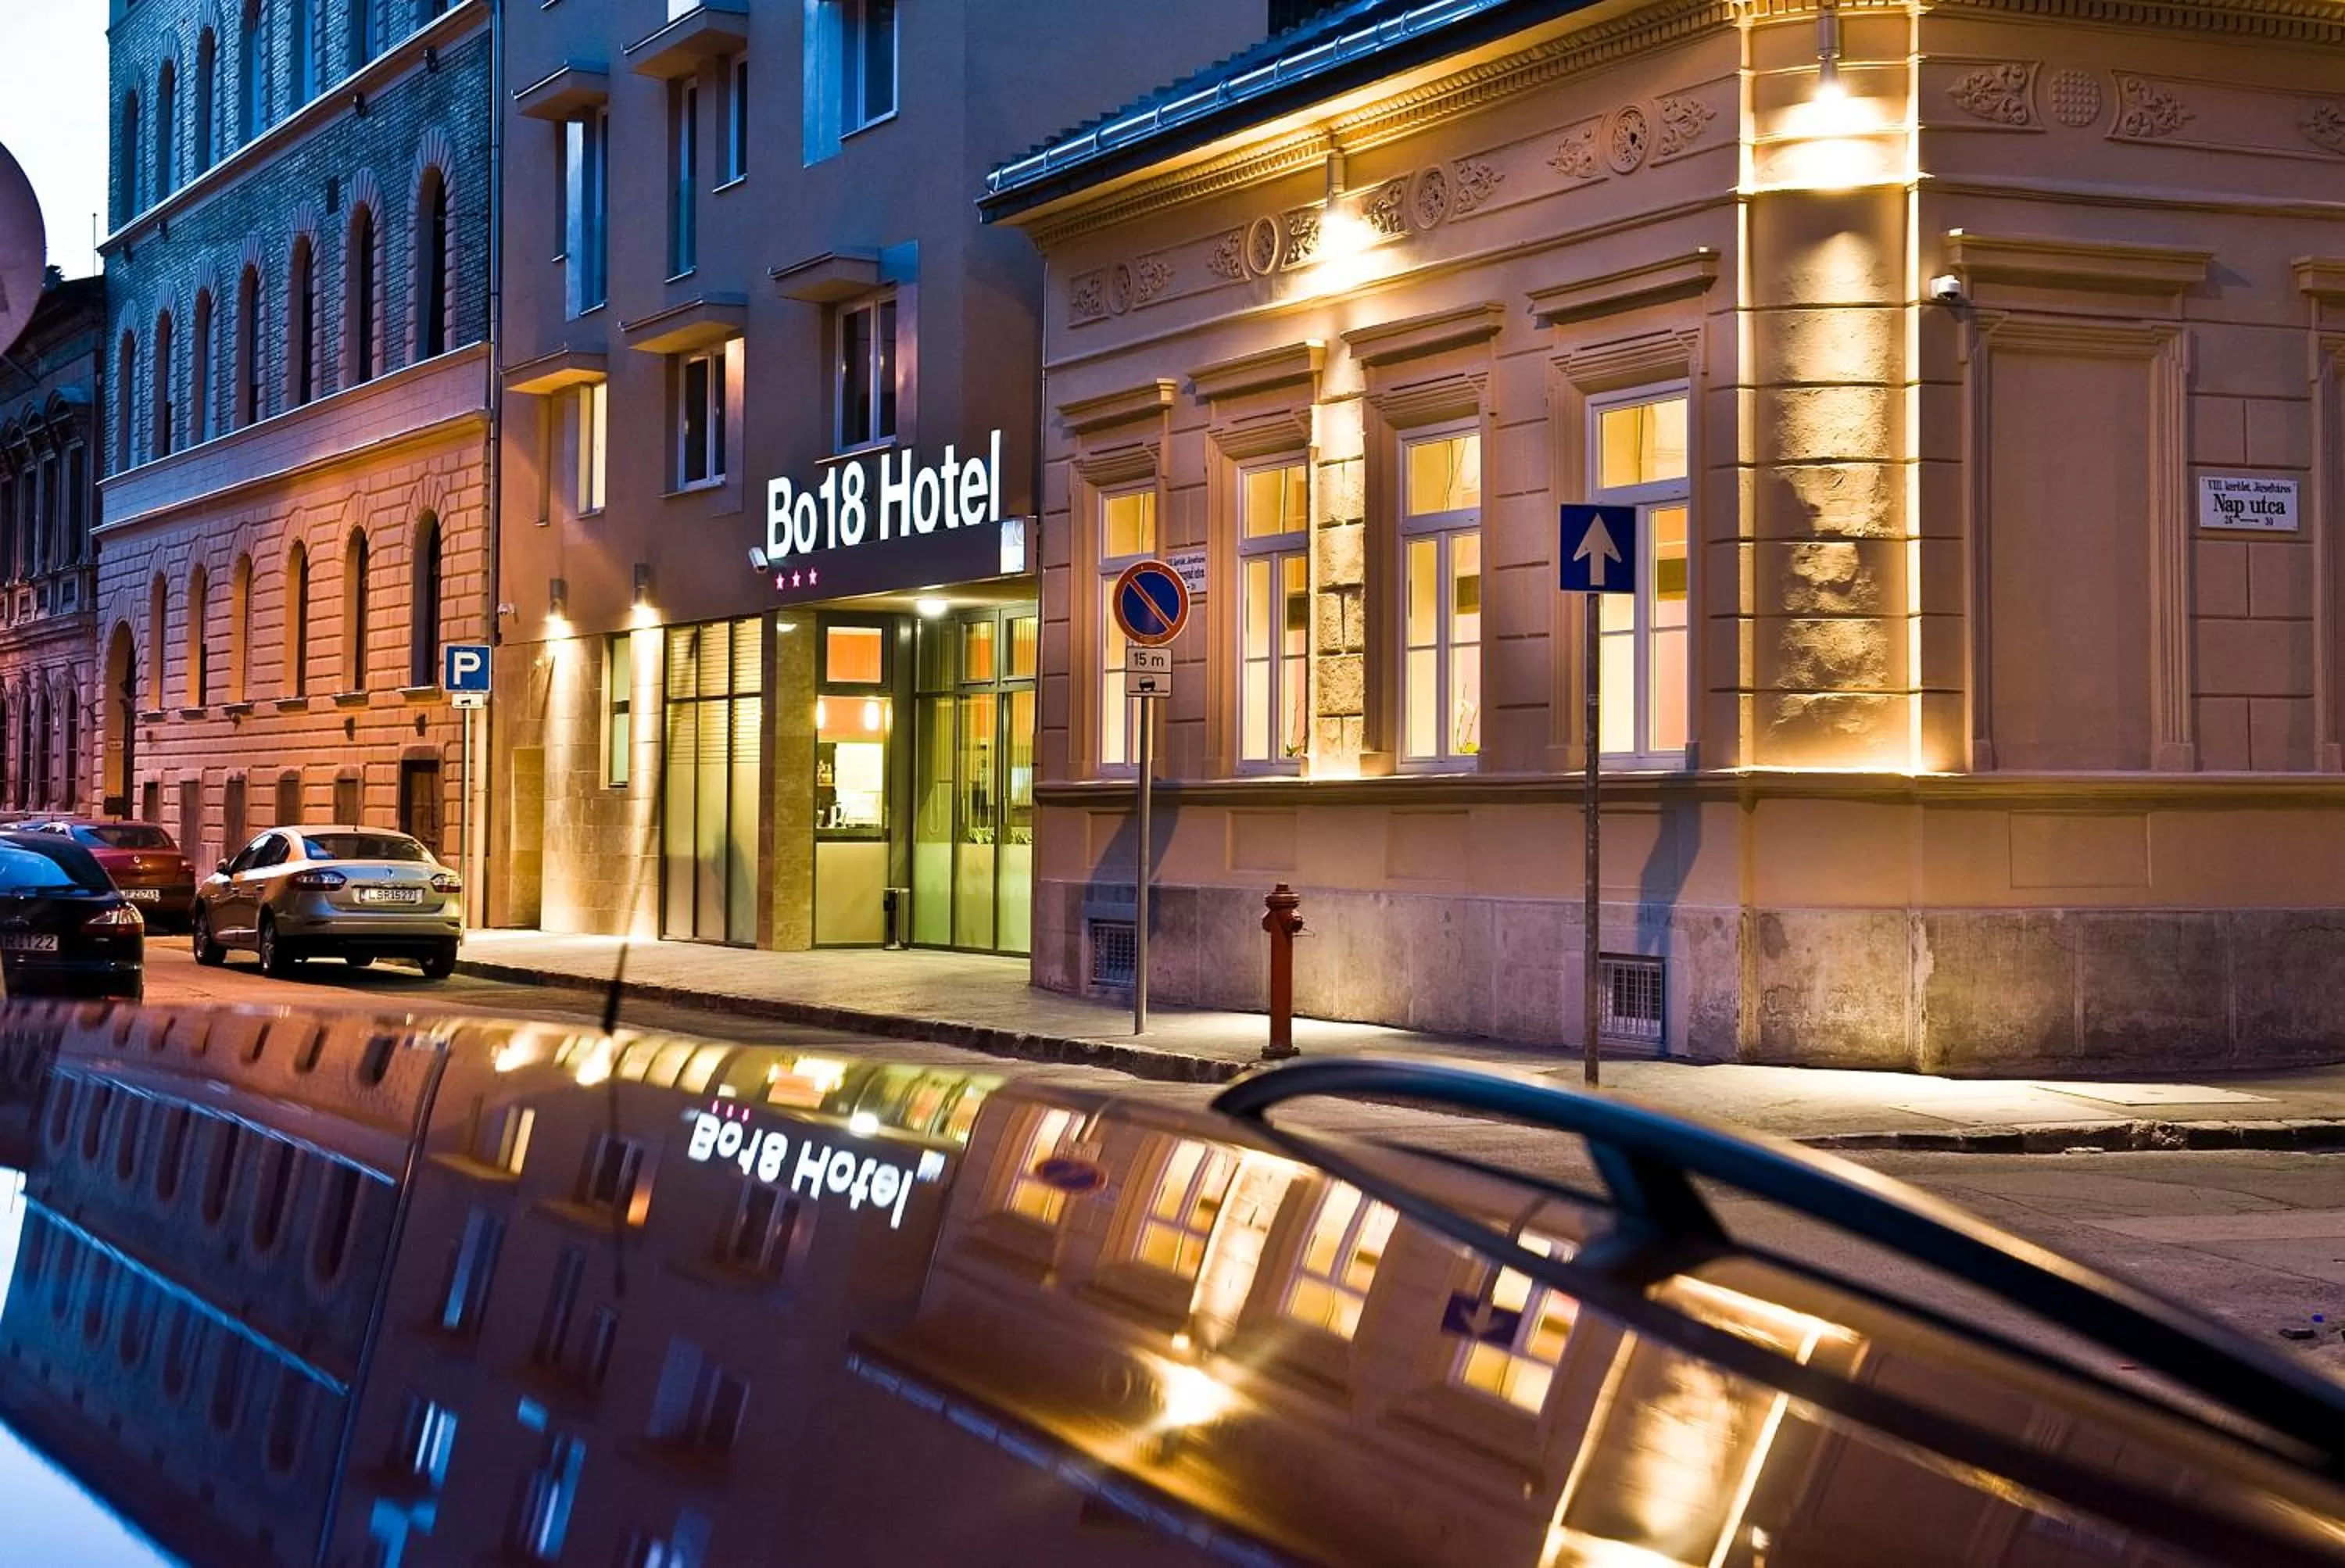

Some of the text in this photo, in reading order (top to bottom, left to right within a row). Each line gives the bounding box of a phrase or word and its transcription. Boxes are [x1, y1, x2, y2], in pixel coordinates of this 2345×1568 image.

[767, 429, 1001, 559] Bo18 Hotel
[2214, 494, 2286, 518] Nap utca
[453, 651, 481, 686] P
[1133, 652, 1164, 667] 15 m
